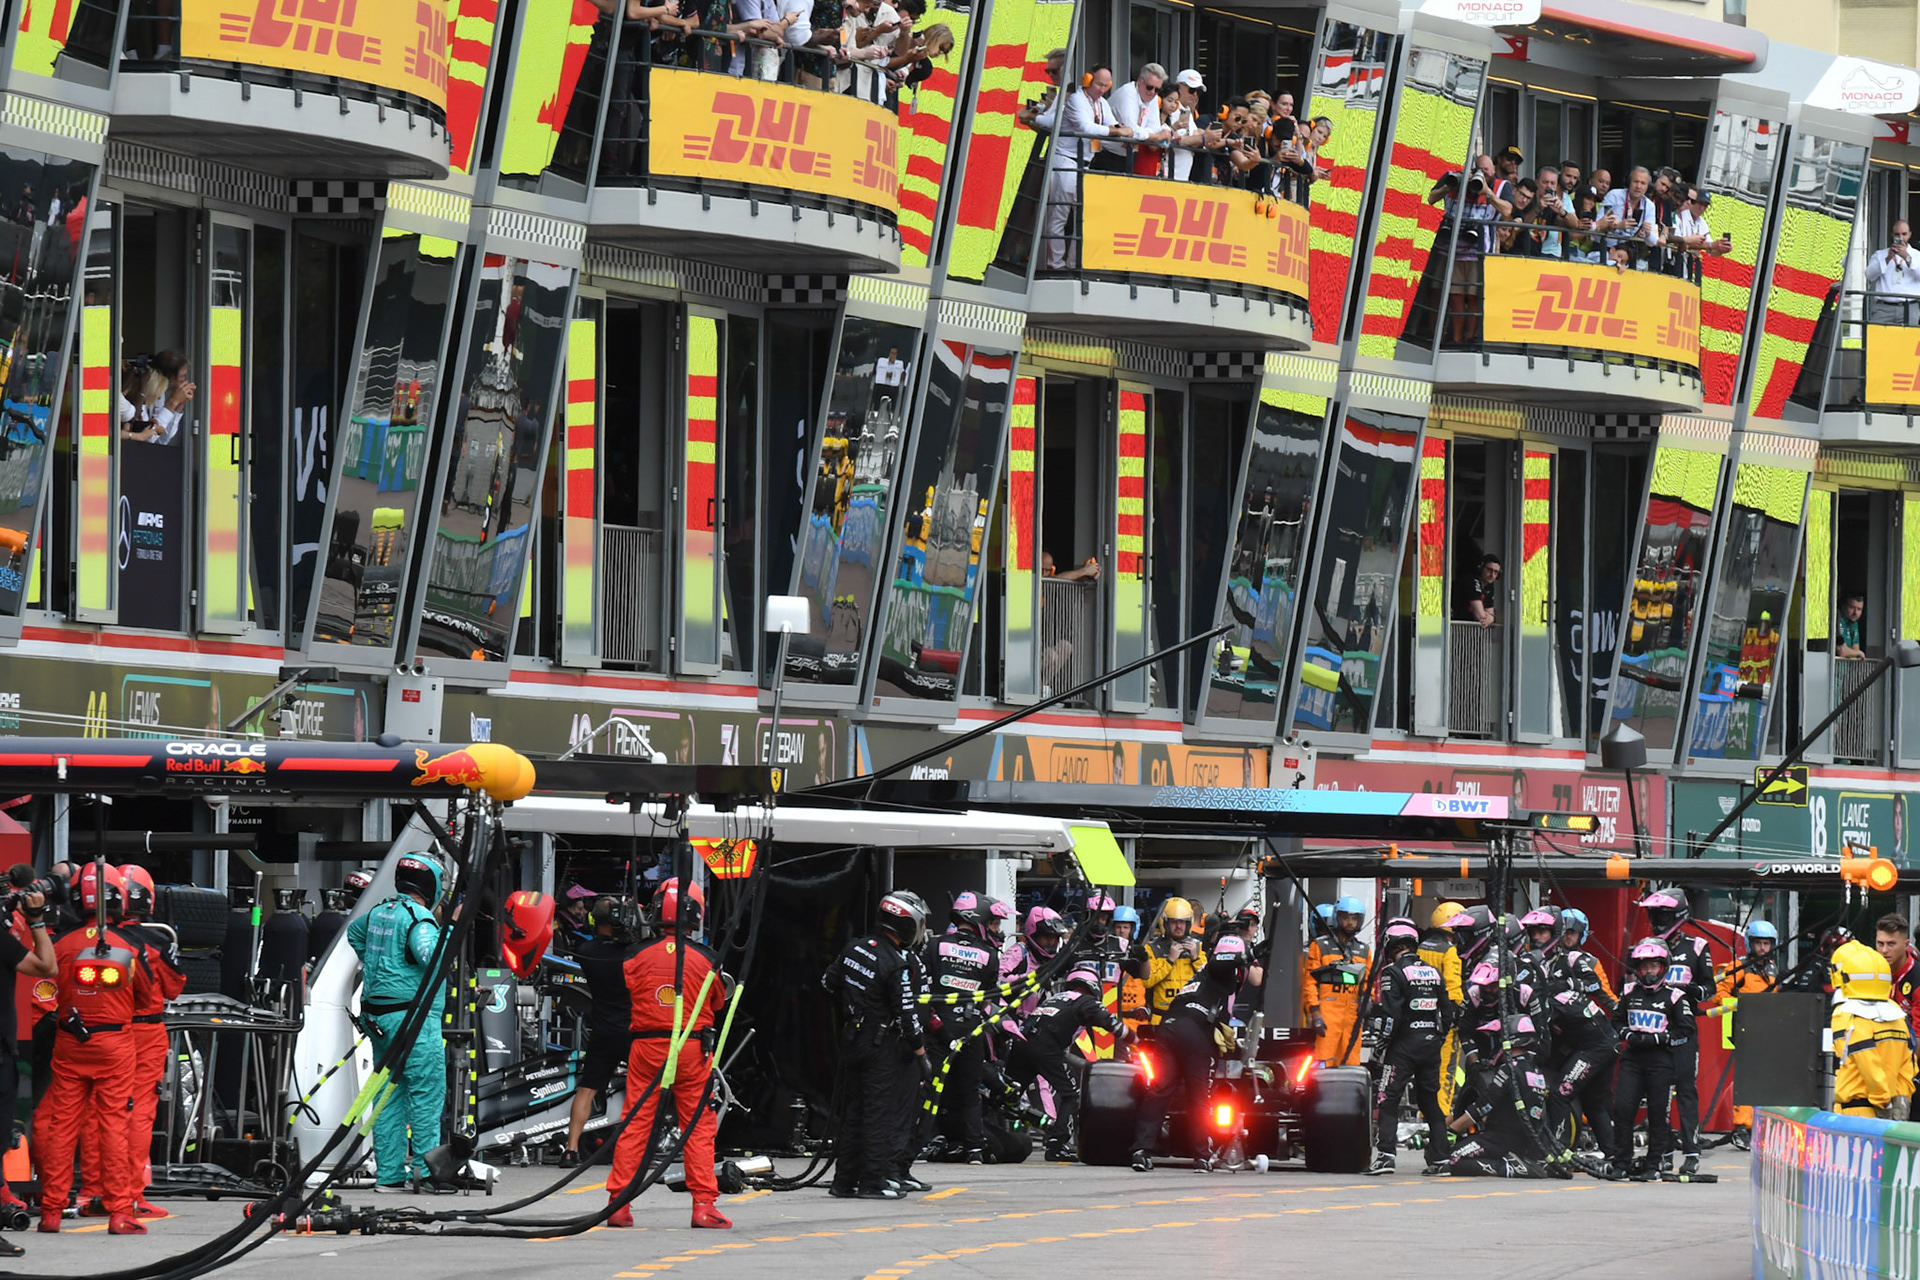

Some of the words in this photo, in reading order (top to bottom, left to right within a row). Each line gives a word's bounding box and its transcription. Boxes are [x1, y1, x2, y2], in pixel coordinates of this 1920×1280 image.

[1457, 3, 1523, 11] MONACO
[1466, 12, 1514, 21] CIRCUIT
[1841, 92, 1903, 100] MONACO
[1848, 101, 1893, 109] CIRCUIT
[709, 91, 816, 174] DHL
[1136, 194, 1232, 266] DHL
[1533, 273, 1625, 338] DHL
[133, 529, 163, 546] PETRONAS
[129, 690, 161, 725] LEWIS
[166, 743, 267, 756] ORACLE
[166, 758, 194, 772] Red
[194, 758, 220, 772] Bull
[166, 778, 266, 786] RACING
[1449, 800, 1489, 813] BWT
[1583, 786, 1620, 813] VALTTERI
[1842, 803, 1870, 828] LANCE
[1809, 796, 1826, 857] 18
[1772, 864, 1791, 874] DP
[1792, 864, 1841, 874] WORLD
[941, 957, 983, 969] ALPINE
[951, 977, 978, 990] Castrol
[1629, 1013, 1664, 1029] BWT
[525, 1066, 559, 1080] PETRONAS
[530, 1081, 566, 1099] Syntium
